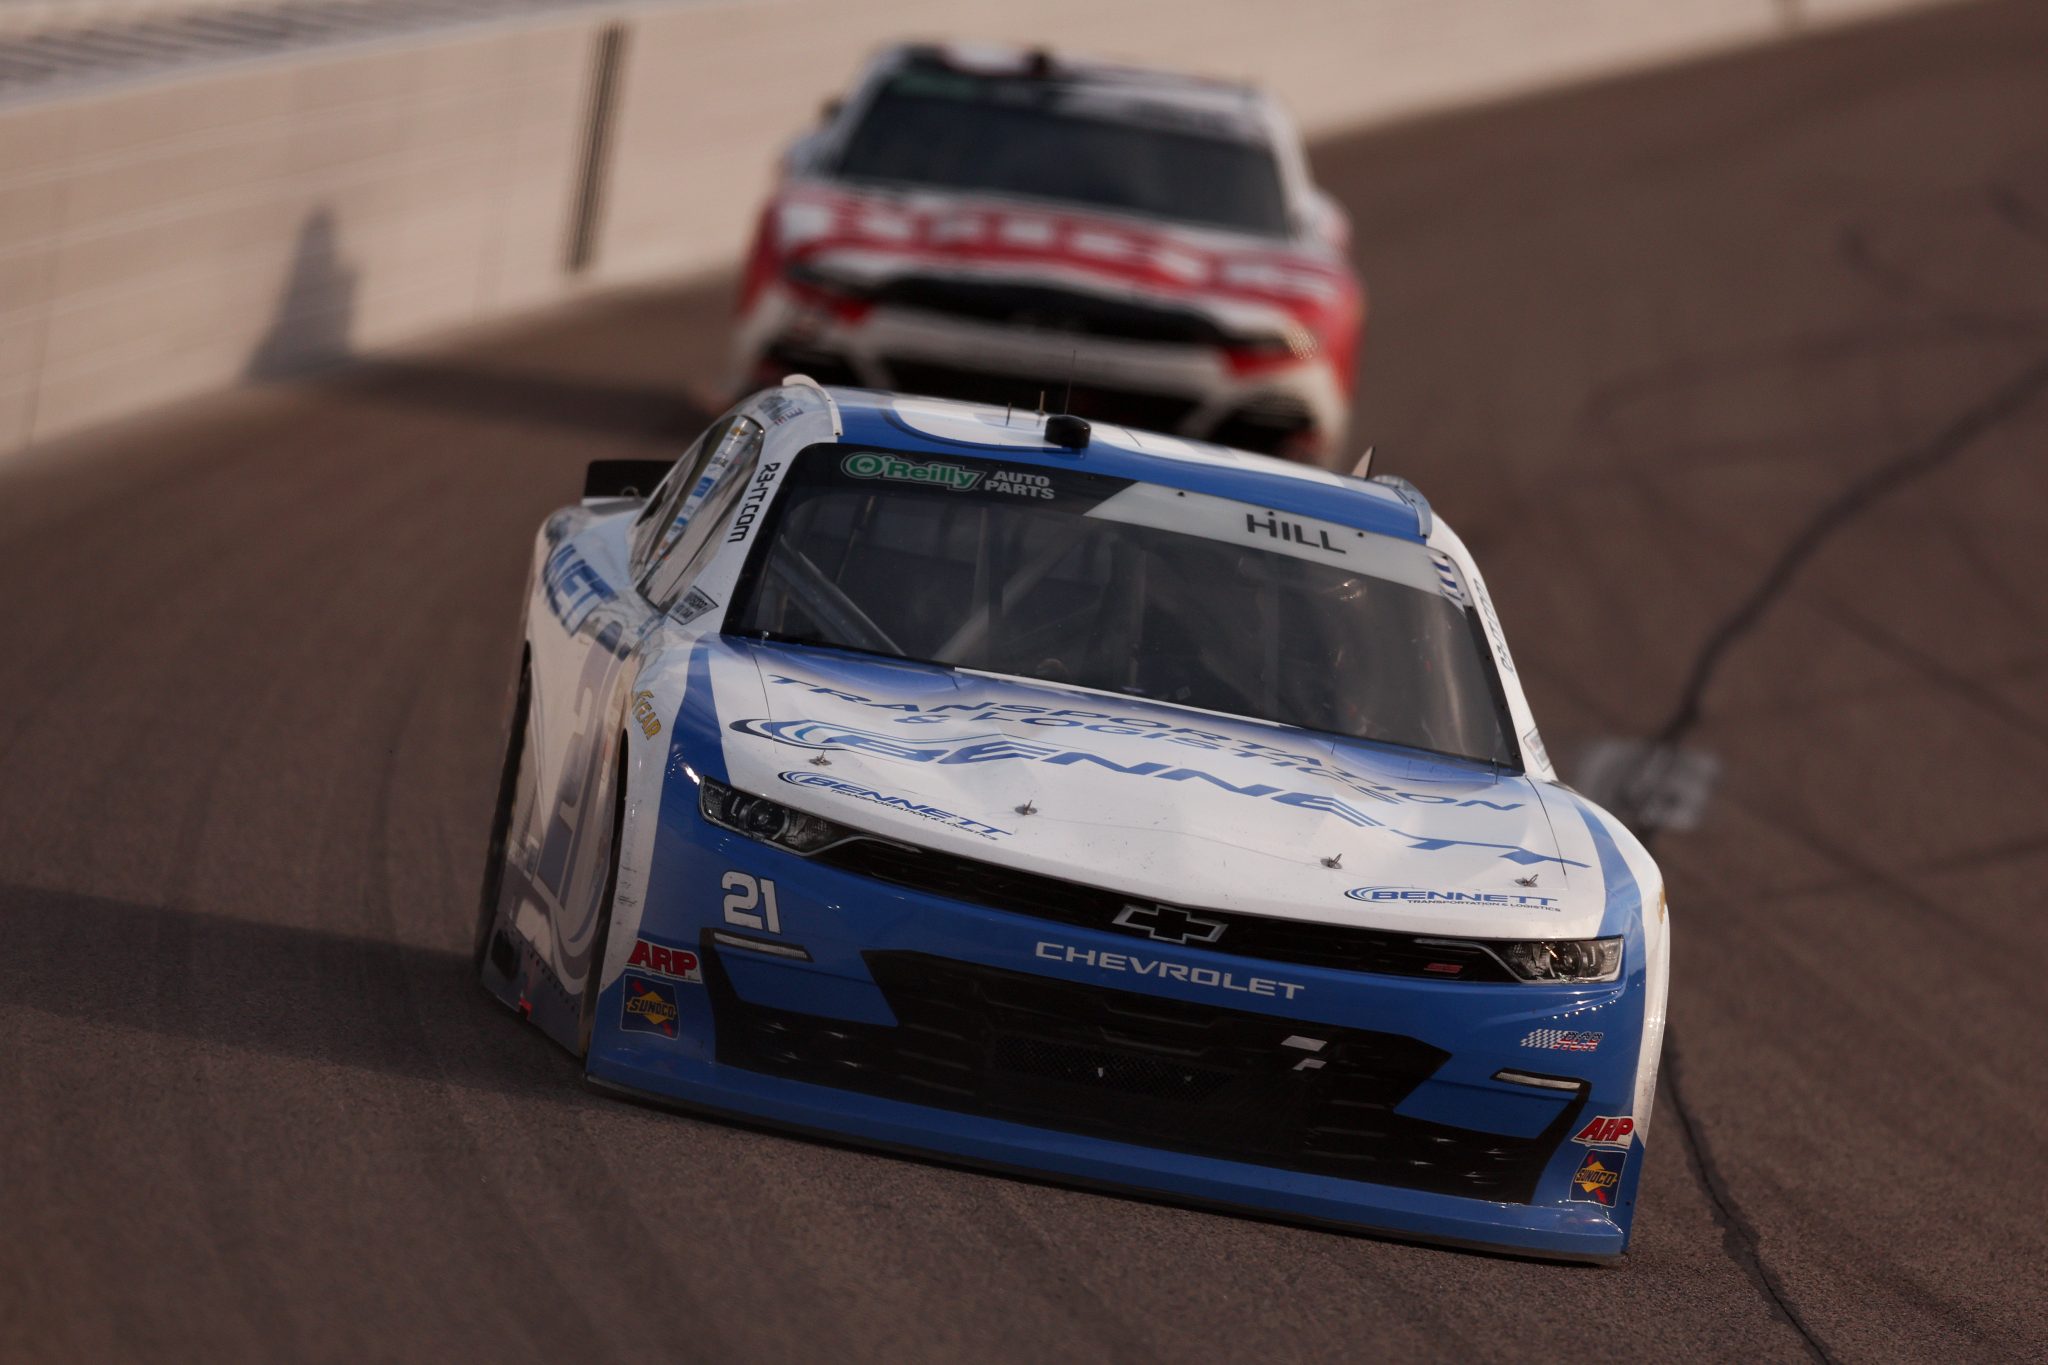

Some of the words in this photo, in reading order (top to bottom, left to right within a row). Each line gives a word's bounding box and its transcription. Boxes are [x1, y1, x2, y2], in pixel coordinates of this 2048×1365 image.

[846, 453, 979, 489] O'Reilly
[993, 471, 1050, 487] AUTO
[984, 479, 1055, 499] PARTS
[1246, 513, 1347, 554] HILL
[766, 673, 1526, 811] TRANSPORTATION
[894, 713, 948, 726] &
[972, 711, 1401, 805] LOGISTICS
[798, 775, 1013, 836] BENNETT
[818, 735, 1592, 869] BENNETT
[830, 788, 931, 822] TRANSPORTATION
[940, 819, 999, 841] LOGISTICS
[720, 871, 782, 934] 21
[1371, 890, 1559, 906] BENNETT
[1407, 899, 1500, 908] TRANSPORTATION
[1509, 902, 1562, 913] LOGISTICS
[626, 939, 698, 977] ARP
[1035, 941, 1305, 1000] CHEVROLET
[628, 998, 676, 1019] SUNOCO
[1573, 1117, 1634, 1142] ARP
[1576, 1168, 1617, 1187] SUNOCO
